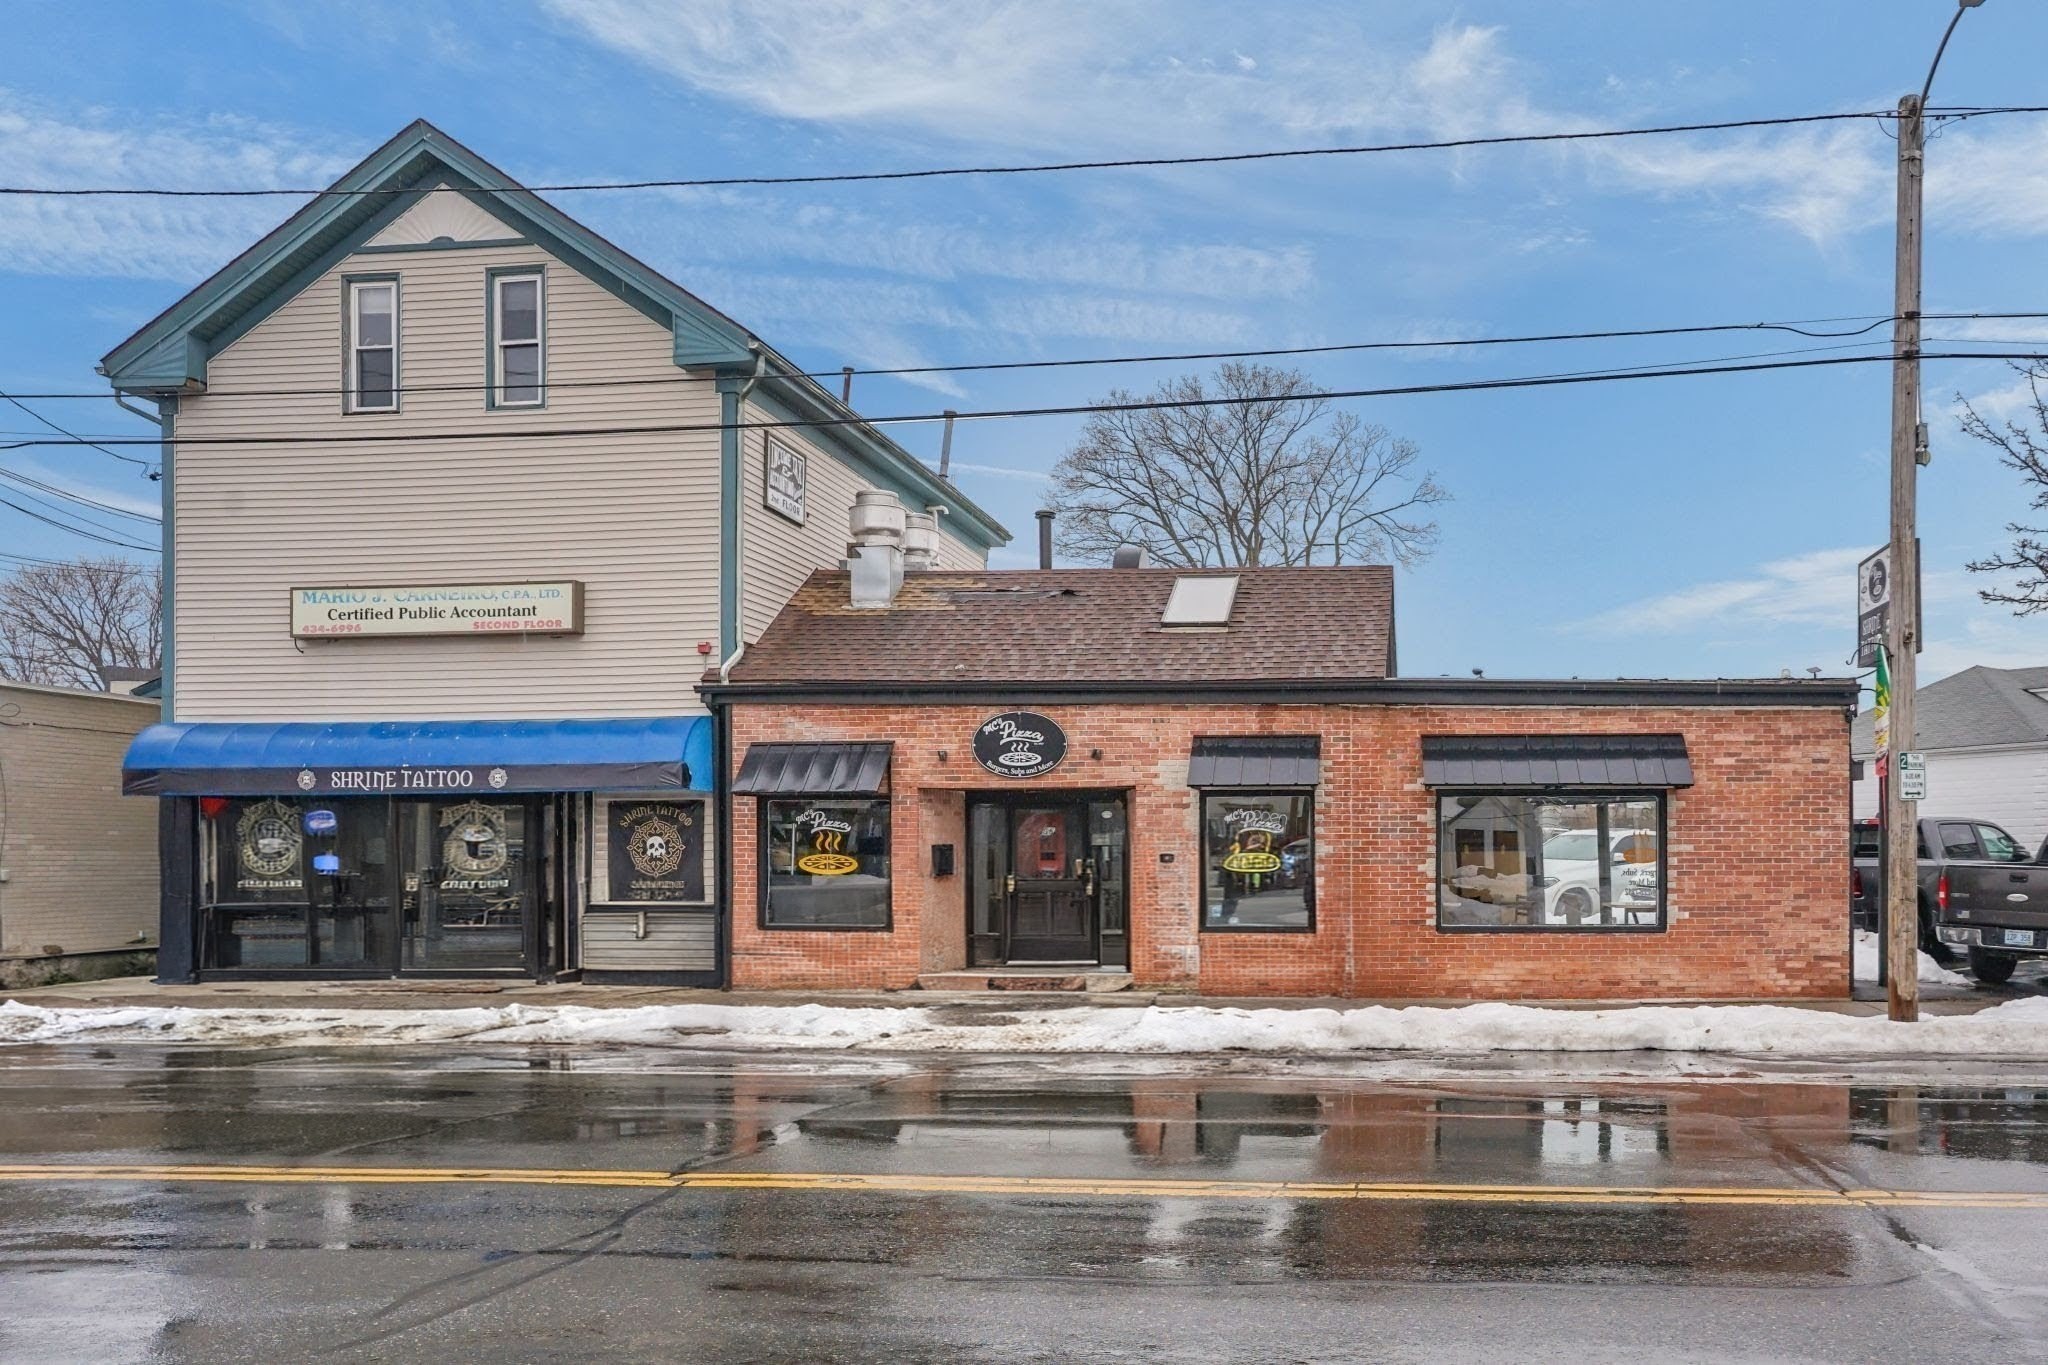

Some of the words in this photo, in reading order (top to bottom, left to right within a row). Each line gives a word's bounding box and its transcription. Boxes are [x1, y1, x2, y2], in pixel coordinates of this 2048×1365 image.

[782, 499, 801, 516] FLOOR
[302, 591, 367, 604] MARIO
[372, 594, 387, 603] J.
[538, 588, 564, 599] LTD.
[327, 607, 394, 621] Certified
[399, 606, 446, 620] Public
[450, 604, 538, 618] Accountant
[473, 620, 520, 630] SECOND
[524, 619, 563, 629] FLOOR
[1000, 721, 1044, 744] Pizza
[986, 760, 1010, 775] Burgers,
[1026, 766, 1038, 774] and
[1038, 761, 1054, 772] More
[1900, 755, 1907, 768] 2
[331, 771, 397, 792] SHRINE
[401, 769, 473, 788] TATTOO
[620, 805, 654, 828] SHRINE
[656, 805, 693, 827] TATTOO
[810, 811, 852, 833] Pizza
[1240, 811, 1285, 833] Pizza
